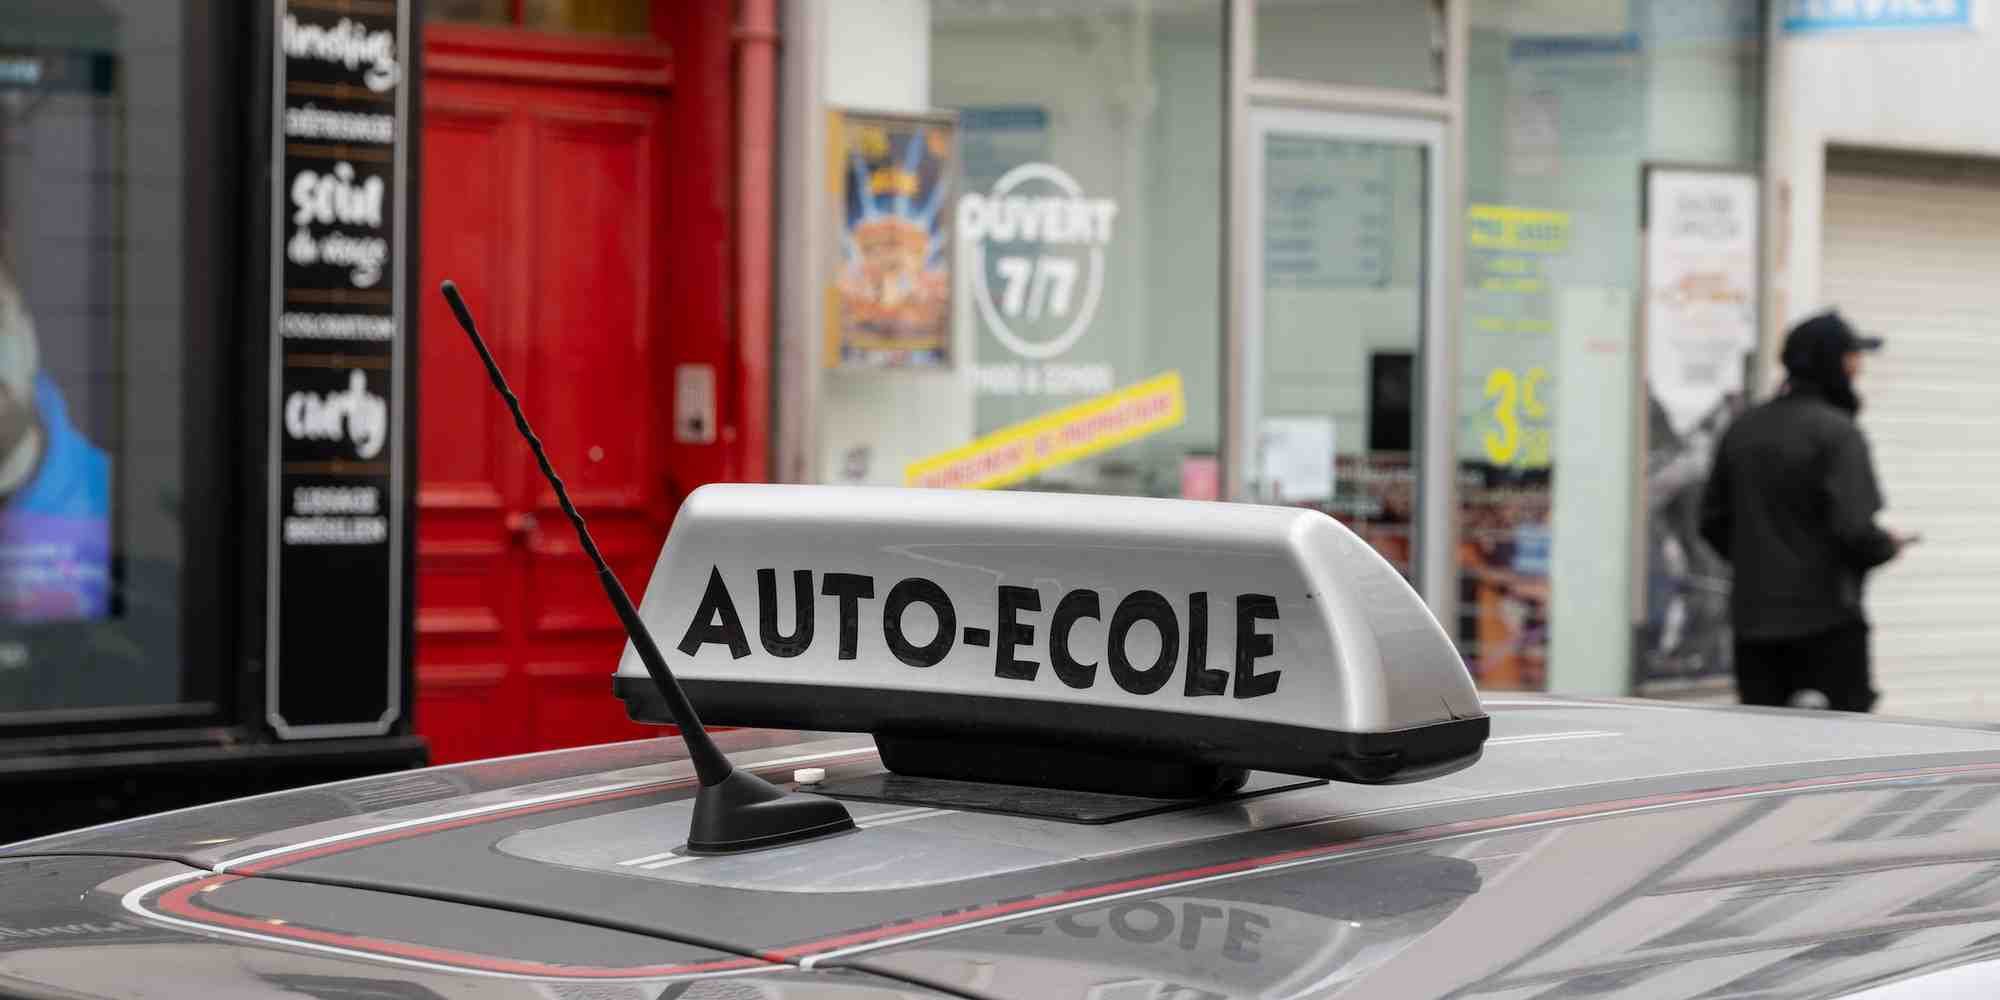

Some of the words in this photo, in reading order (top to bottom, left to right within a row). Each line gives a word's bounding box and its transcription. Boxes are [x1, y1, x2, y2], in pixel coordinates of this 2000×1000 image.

[292, 161, 384, 227] soin
[959, 195, 1118, 242] OUVERT
[998, 257, 1078, 318] 7/7
[285, 369, 387, 458] curly
[677, 564, 1282, 699] AUTO-ECOLE
